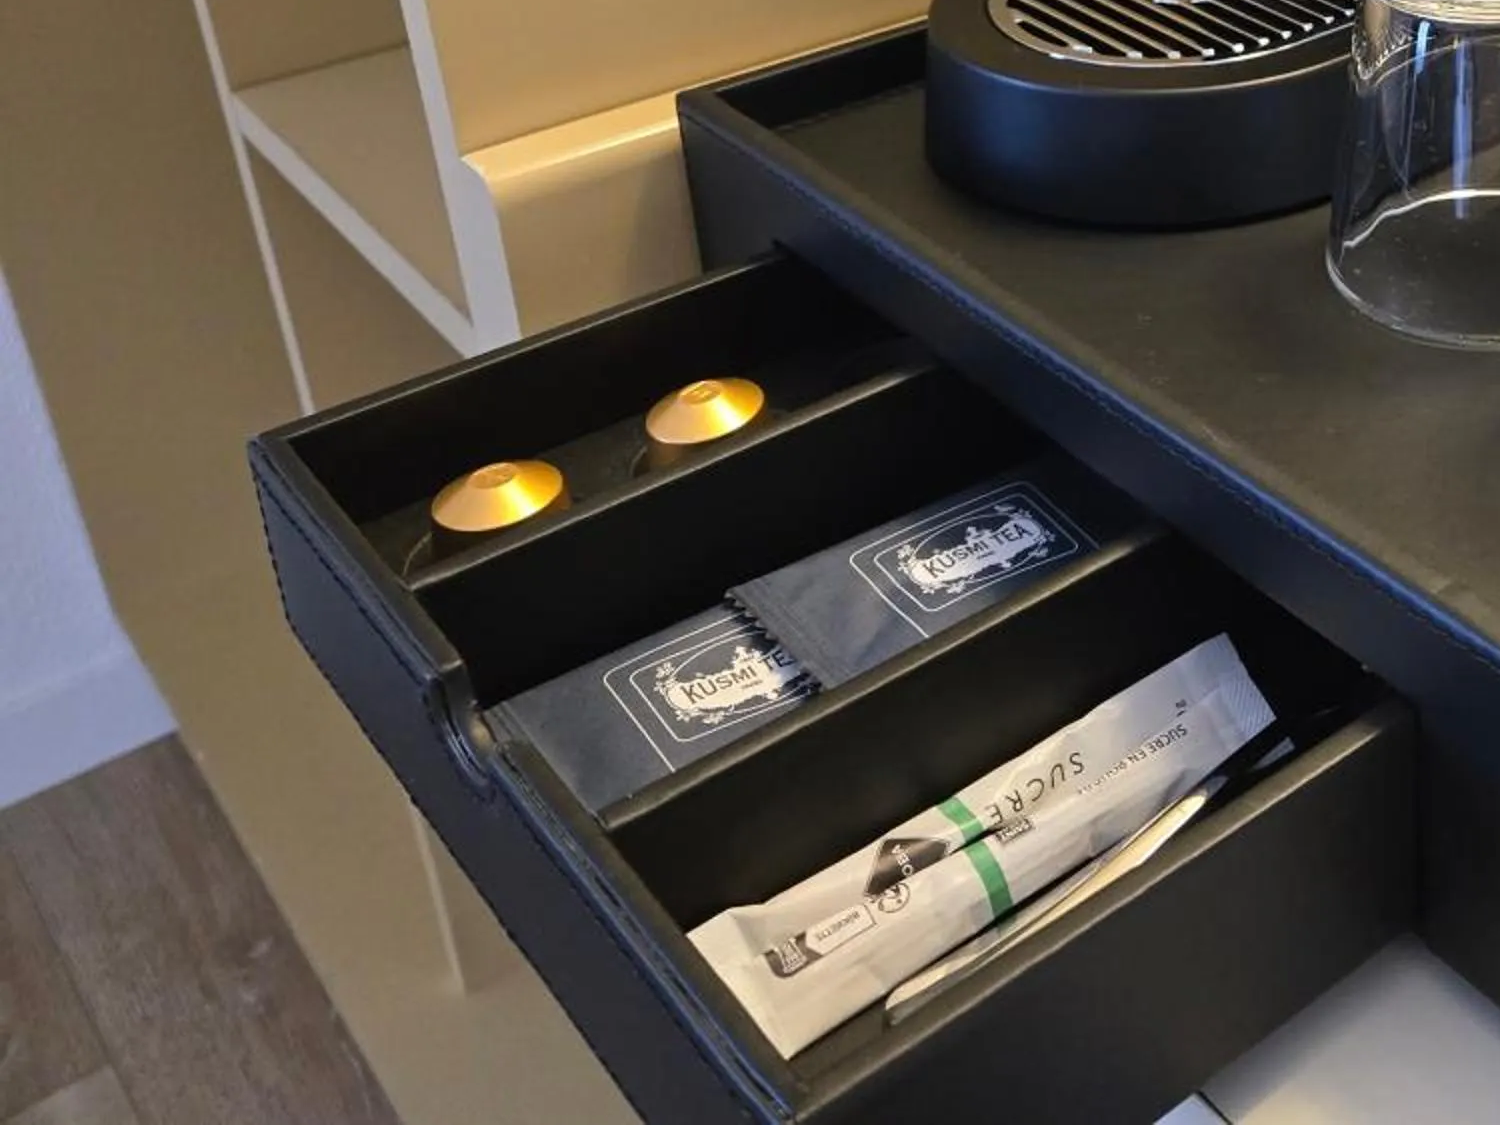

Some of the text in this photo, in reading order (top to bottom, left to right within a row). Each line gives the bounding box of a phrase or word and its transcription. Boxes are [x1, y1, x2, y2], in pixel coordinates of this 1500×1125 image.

[923, 523, 1034, 578] KUSMI TEA
[680, 650, 797, 705] KUSMI TE
[1144, 723, 1188, 754] SUCRE
[985, 752, 1085, 825] SUCRE
